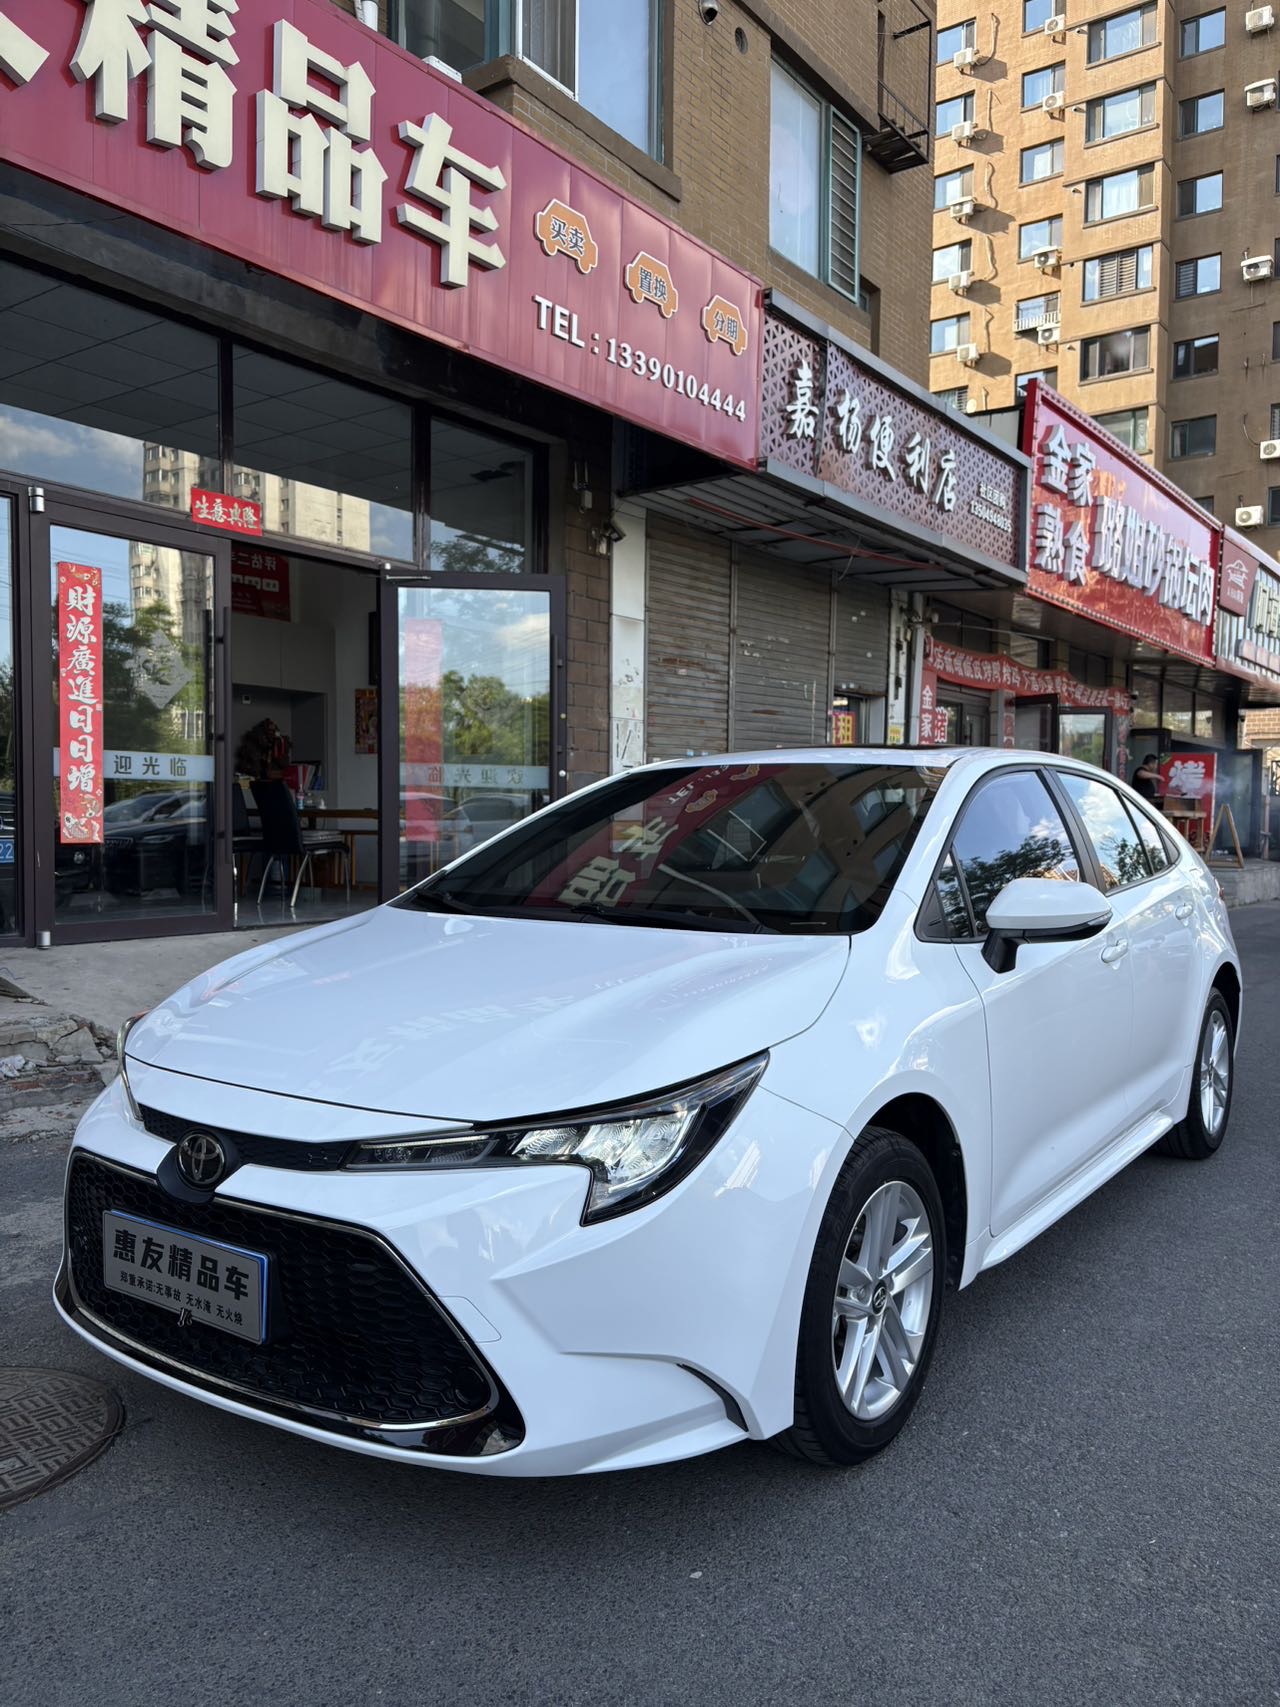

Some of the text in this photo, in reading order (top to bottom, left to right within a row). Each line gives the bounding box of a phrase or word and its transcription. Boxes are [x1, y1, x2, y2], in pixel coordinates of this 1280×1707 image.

[0, 0, 507, 288] 精品车
[551, 216, 585, 255] 买卖
[639, 266, 667, 302] 置换
[714, 310, 739, 341] 分期
[1040, 424, 1096, 507] 金家
[1035, 503, 1090, 586] 熟食
[920, 685, 934, 745] 金家
[113, 1229, 250, 1301] 惠友精品车
[216, 1304, 243, 1326] 无火烧
